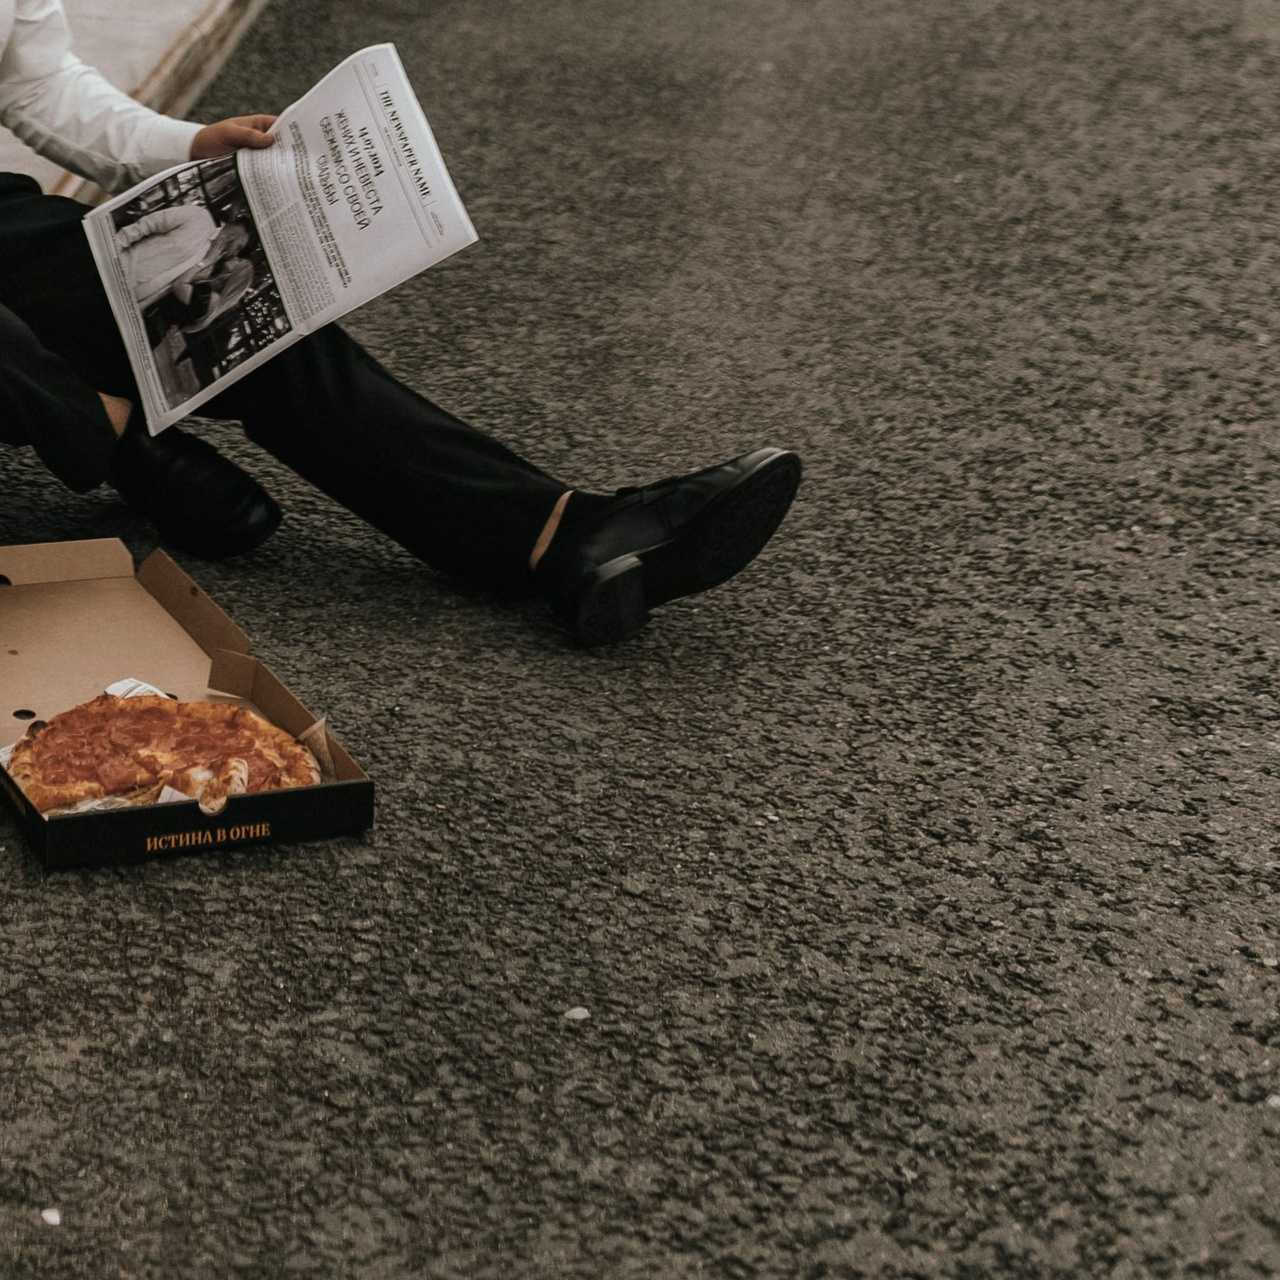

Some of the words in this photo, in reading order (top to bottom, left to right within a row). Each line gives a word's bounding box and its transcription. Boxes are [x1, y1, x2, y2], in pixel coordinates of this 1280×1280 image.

[335, 109, 356, 148] ЖЕНИХ
[352, 156, 383, 216] НЕВЕСТА
[358, 127, 384, 177] 14.07.2024
[379, 90, 393, 111] THE
[388, 111, 418, 168] NEWSPAPER
[411, 168, 432, 200] NAME
[316, 155, 339, 206] СВАДЬБЫ
[335, 165, 350, 184] СО
[343, 185, 372, 230] СВОЕЙ
[146, 830, 213, 851] ИСТИНА
[217, 828, 227, 842] В
[230, 823, 270, 840] ОГНЕ
